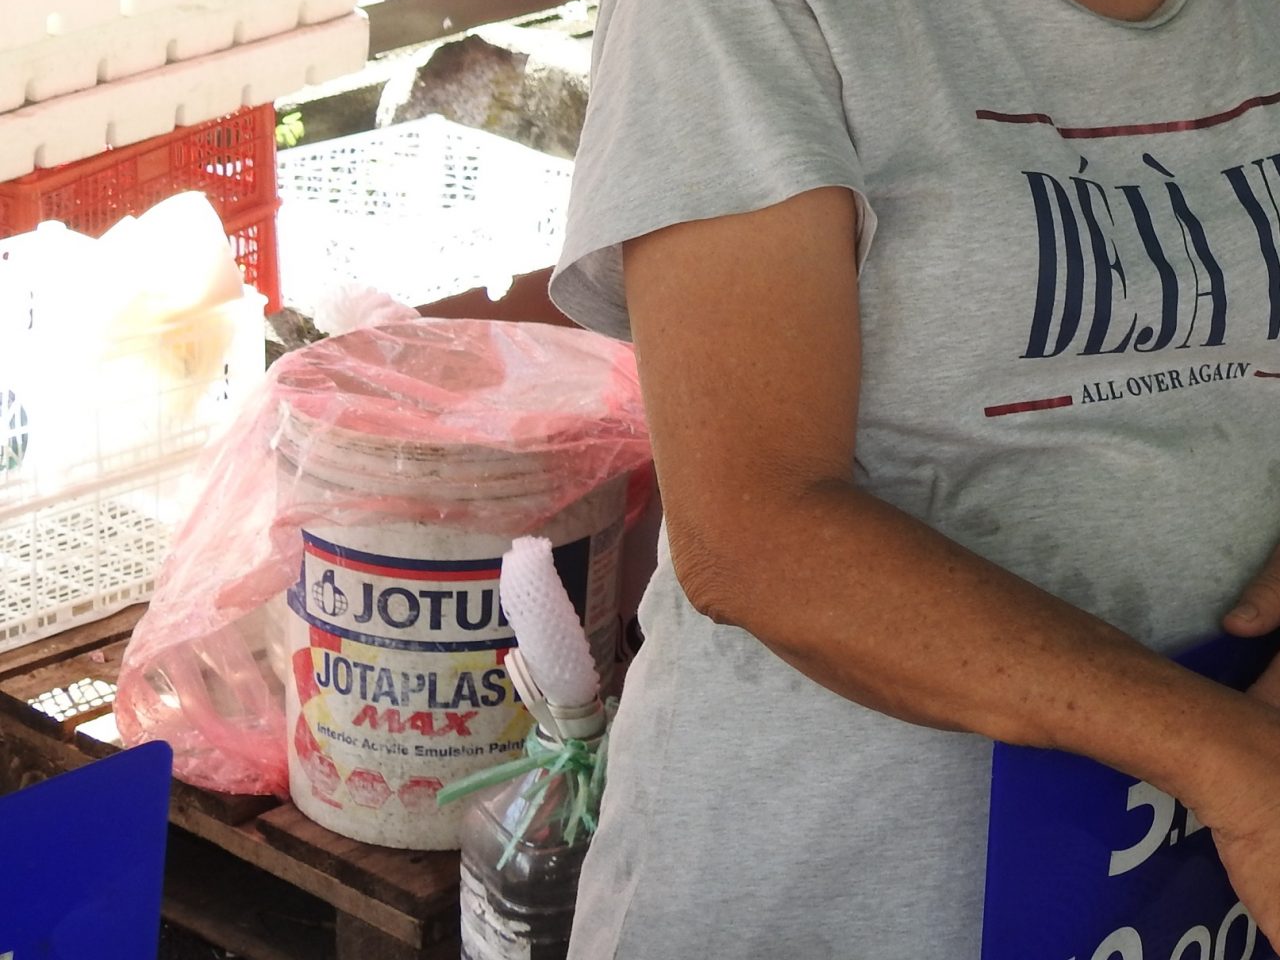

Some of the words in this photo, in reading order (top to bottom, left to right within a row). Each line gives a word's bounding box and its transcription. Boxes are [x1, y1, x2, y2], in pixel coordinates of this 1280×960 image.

[1019, 153, 1228, 359] DÉJÀ
[1081, 380, 1123, 404] ALL
[1126, 369, 1184, 396] OVER
[1188, 362, 1251, 386] AGAIN
[353, 582, 509, 631] JOTU
[317, 722, 358, 746] Interior
[414, 745, 485, 758] Emulsion
[352, 705, 480, 737] MAX
